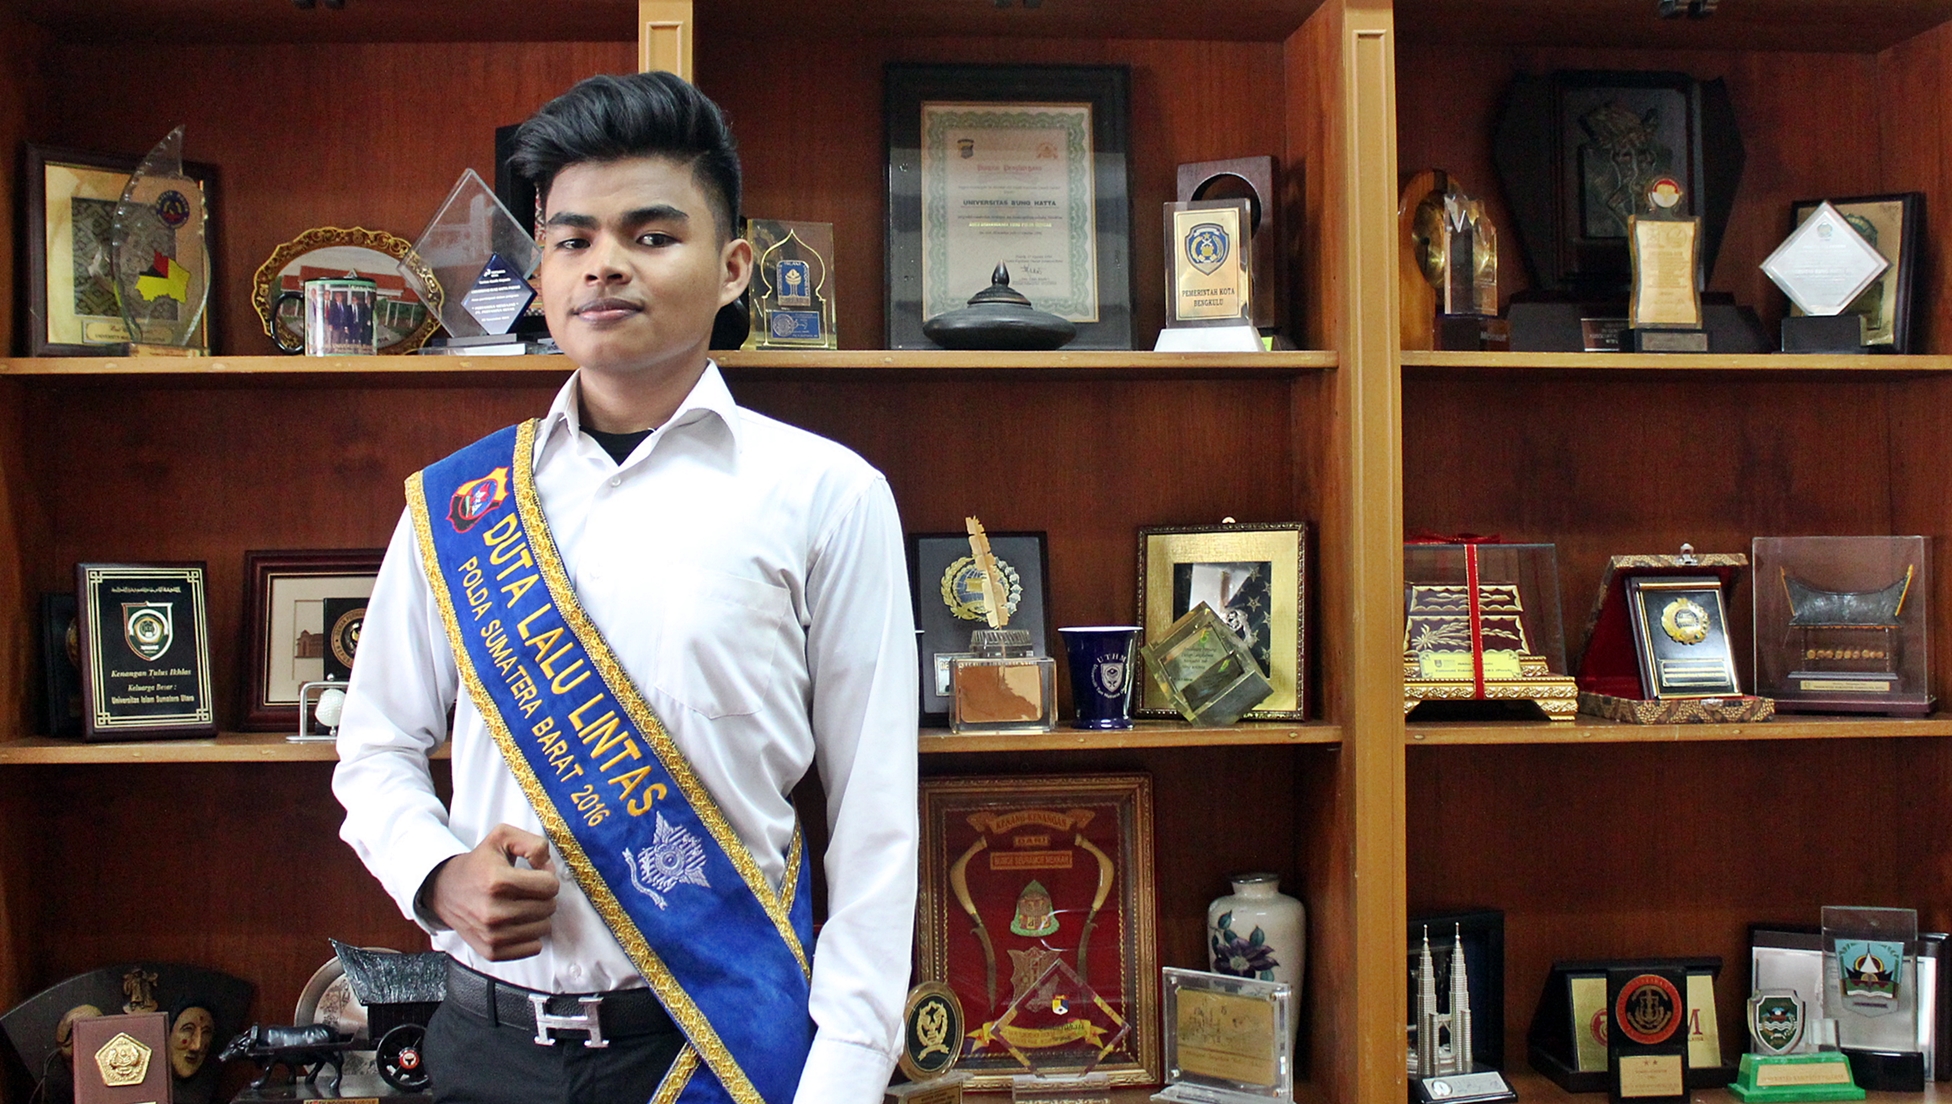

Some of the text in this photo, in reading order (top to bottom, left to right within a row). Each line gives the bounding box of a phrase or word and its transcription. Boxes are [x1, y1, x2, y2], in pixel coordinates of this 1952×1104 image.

[1181, 287, 1235, 298] PEMERINTAH KOTA
[1193, 298, 1224, 307] BENGKULU
[1097, 653, 1126, 663] UTHM
[483, 512, 667, 817] DUTA LALU LINTAS
[111, 669, 147, 678] Kenangan
[458, 555, 611, 827] POLDA SUMATERA BARAT 2016
[1017, 837, 1047, 845] DARI
